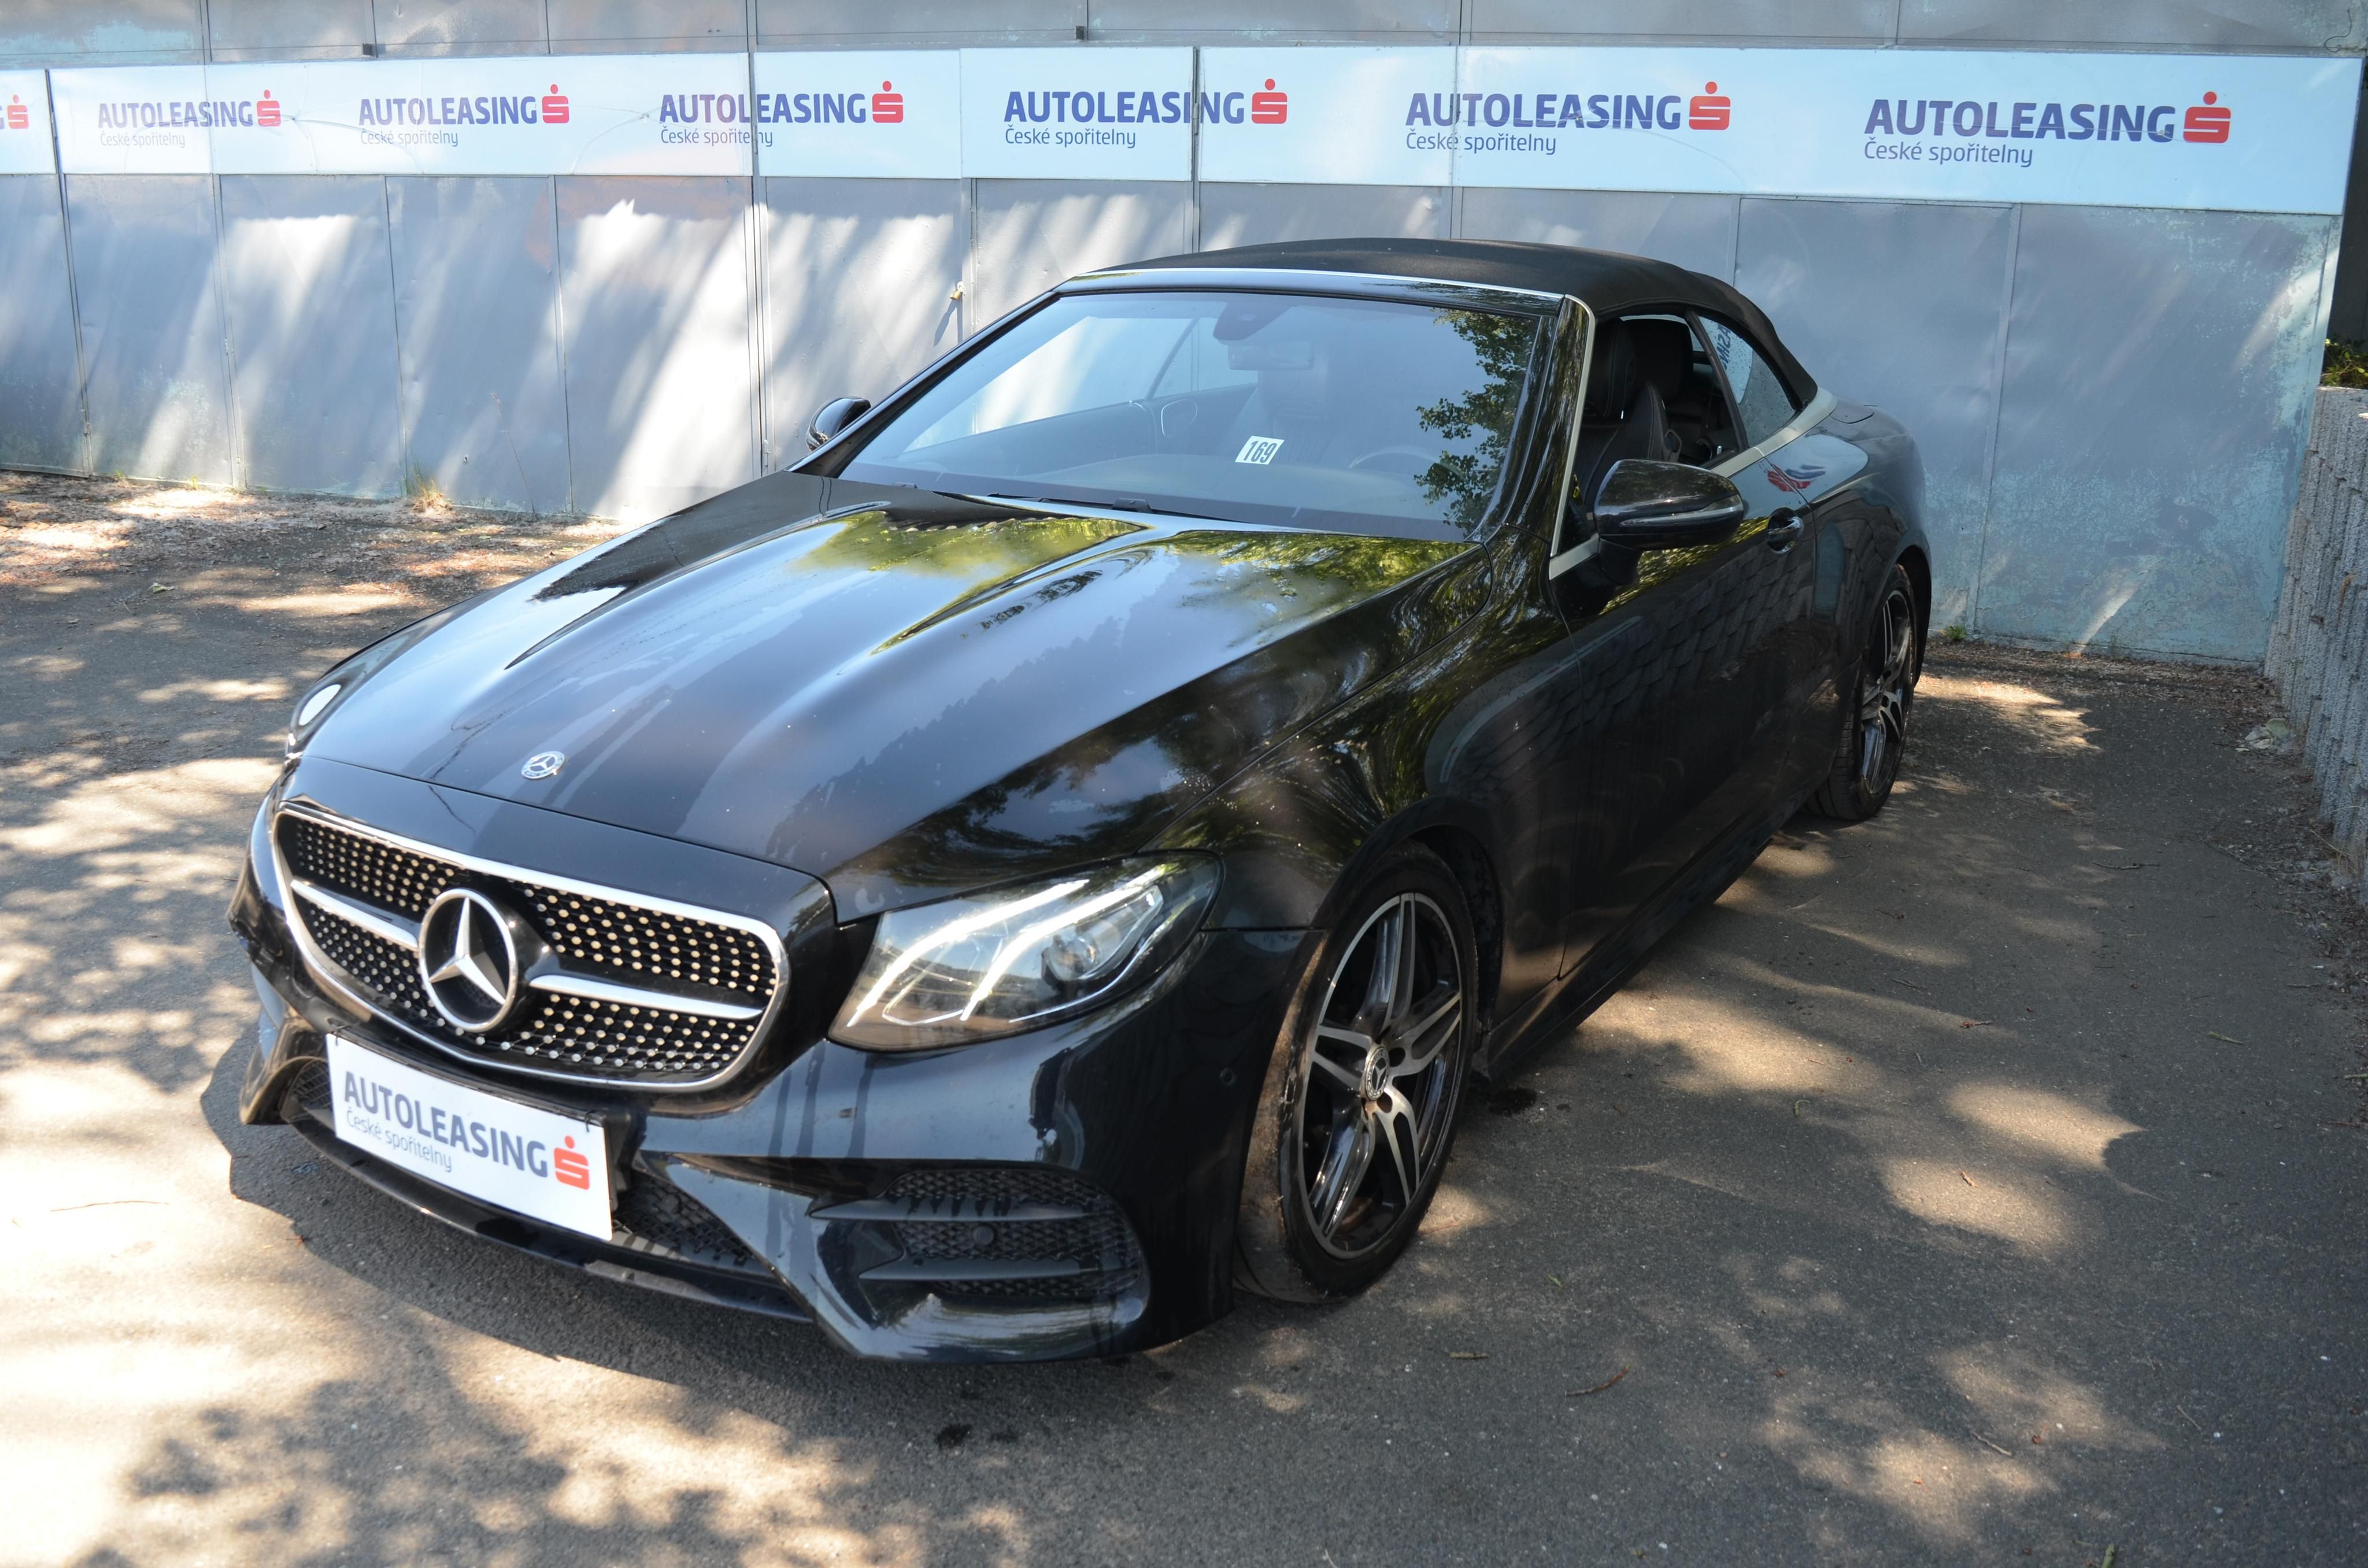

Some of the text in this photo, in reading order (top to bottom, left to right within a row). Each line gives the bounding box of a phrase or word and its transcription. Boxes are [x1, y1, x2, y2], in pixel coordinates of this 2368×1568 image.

[98, 101, 253, 128] AUTOLEASING
[359, 96, 537, 125] AUTOLEASING
[660, 93, 867, 123] AUTOLEASING
[1004, 91, 1245, 124] AUTOLEASING
[1405, 93, 1681, 130] AUTOLEASING
[1864, 99, 2176, 143] AUTOLEASING
[101, 131, 186, 148] České spořitelny
[361, 129, 458, 147] České spořitelny
[661, 126, 774, 147] České spořiteny
[1005, 124, 1136, 149] České spořitelny
[1406, 128, 1556, 155] České spořitelny
[1864, 137, 2033, 168] České spořitelny
[1244, 440, 1278, 464] 169
[344, 1070, 549, 1178] AUTOLEASING
[346, 1110, 453, 1173] České spořitelny
